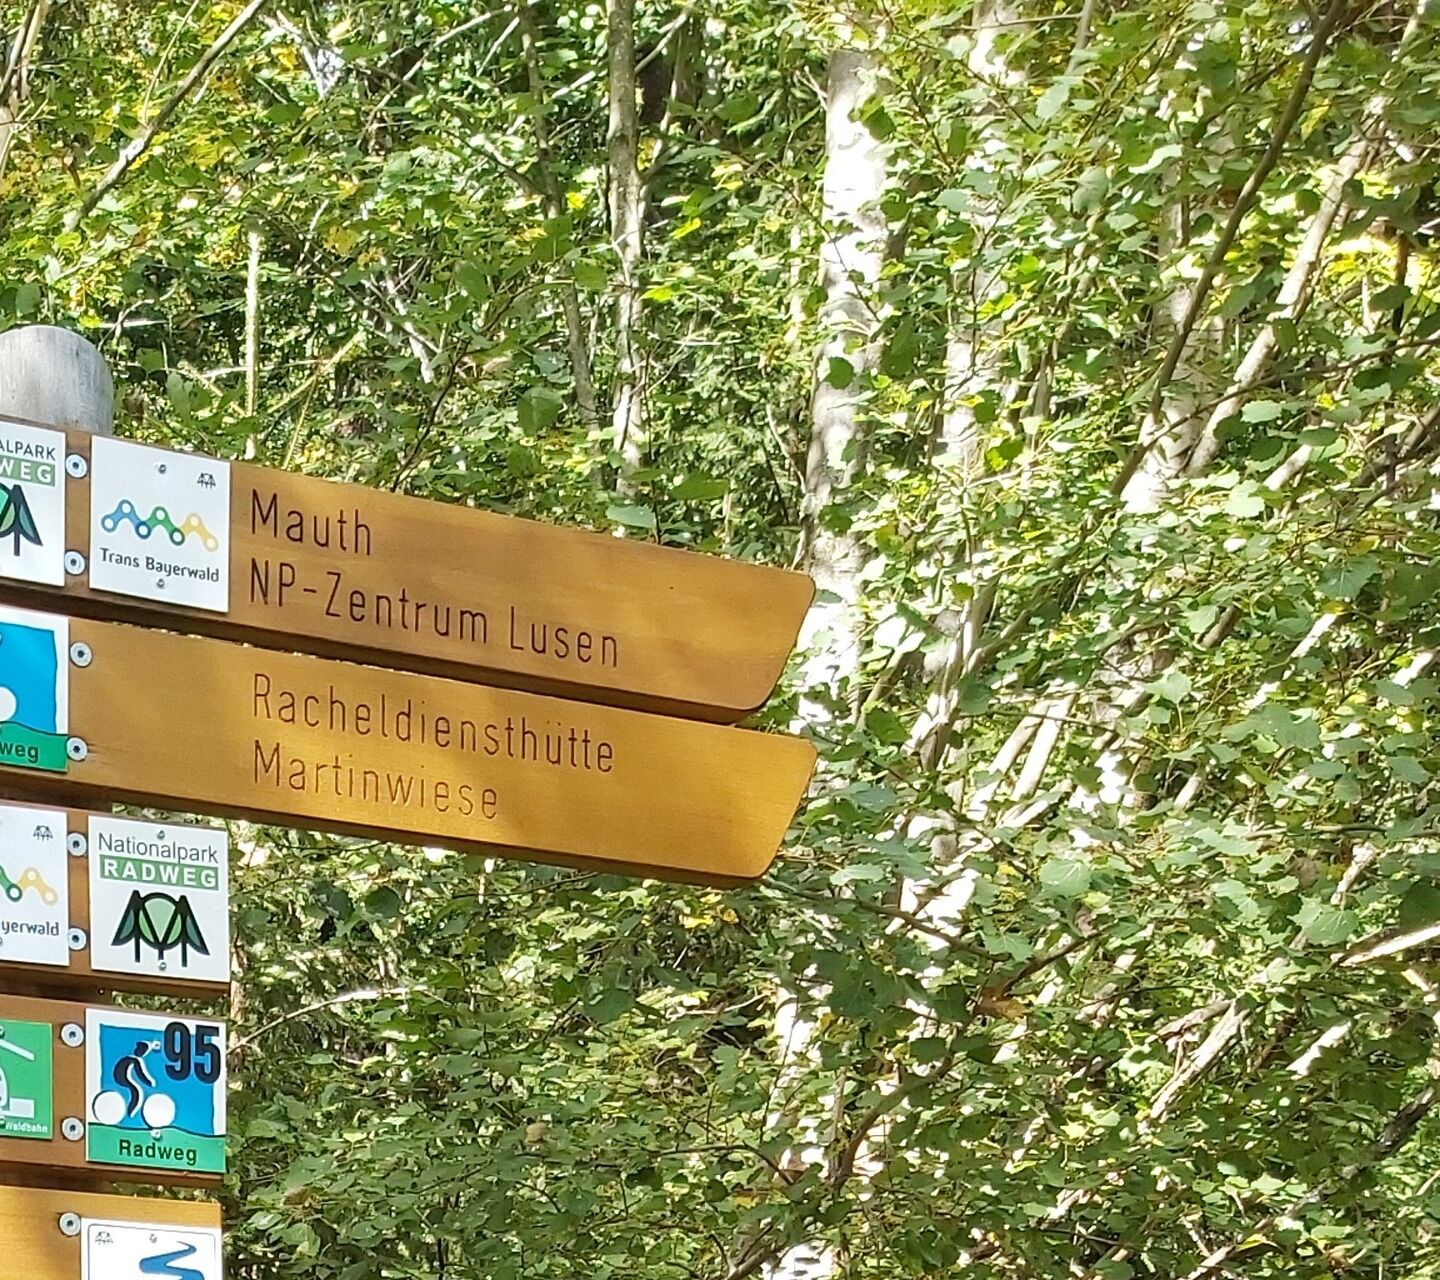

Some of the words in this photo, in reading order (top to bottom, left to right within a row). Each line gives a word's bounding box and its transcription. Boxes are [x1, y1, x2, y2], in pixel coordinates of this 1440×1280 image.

[251, 489, 372, 556] Mauth
[99, 547, 140, 569] Trans
[145, 556, 220, 583] Bayerwald
[250, 557, 488, 645] NP-Zentrum
[509, 606, 618, 668] Lusen
[252, 672, 614, 773] Racheldiensthütte
[253, 740, 498, 820] Martinwiese
[98, 832, 219, 864] Nationalpark
[104, 859, 217, 888] RADWEG
[163, 1021, 221, 1084] 95
[119, 1138, 197, 1166] Radweg
